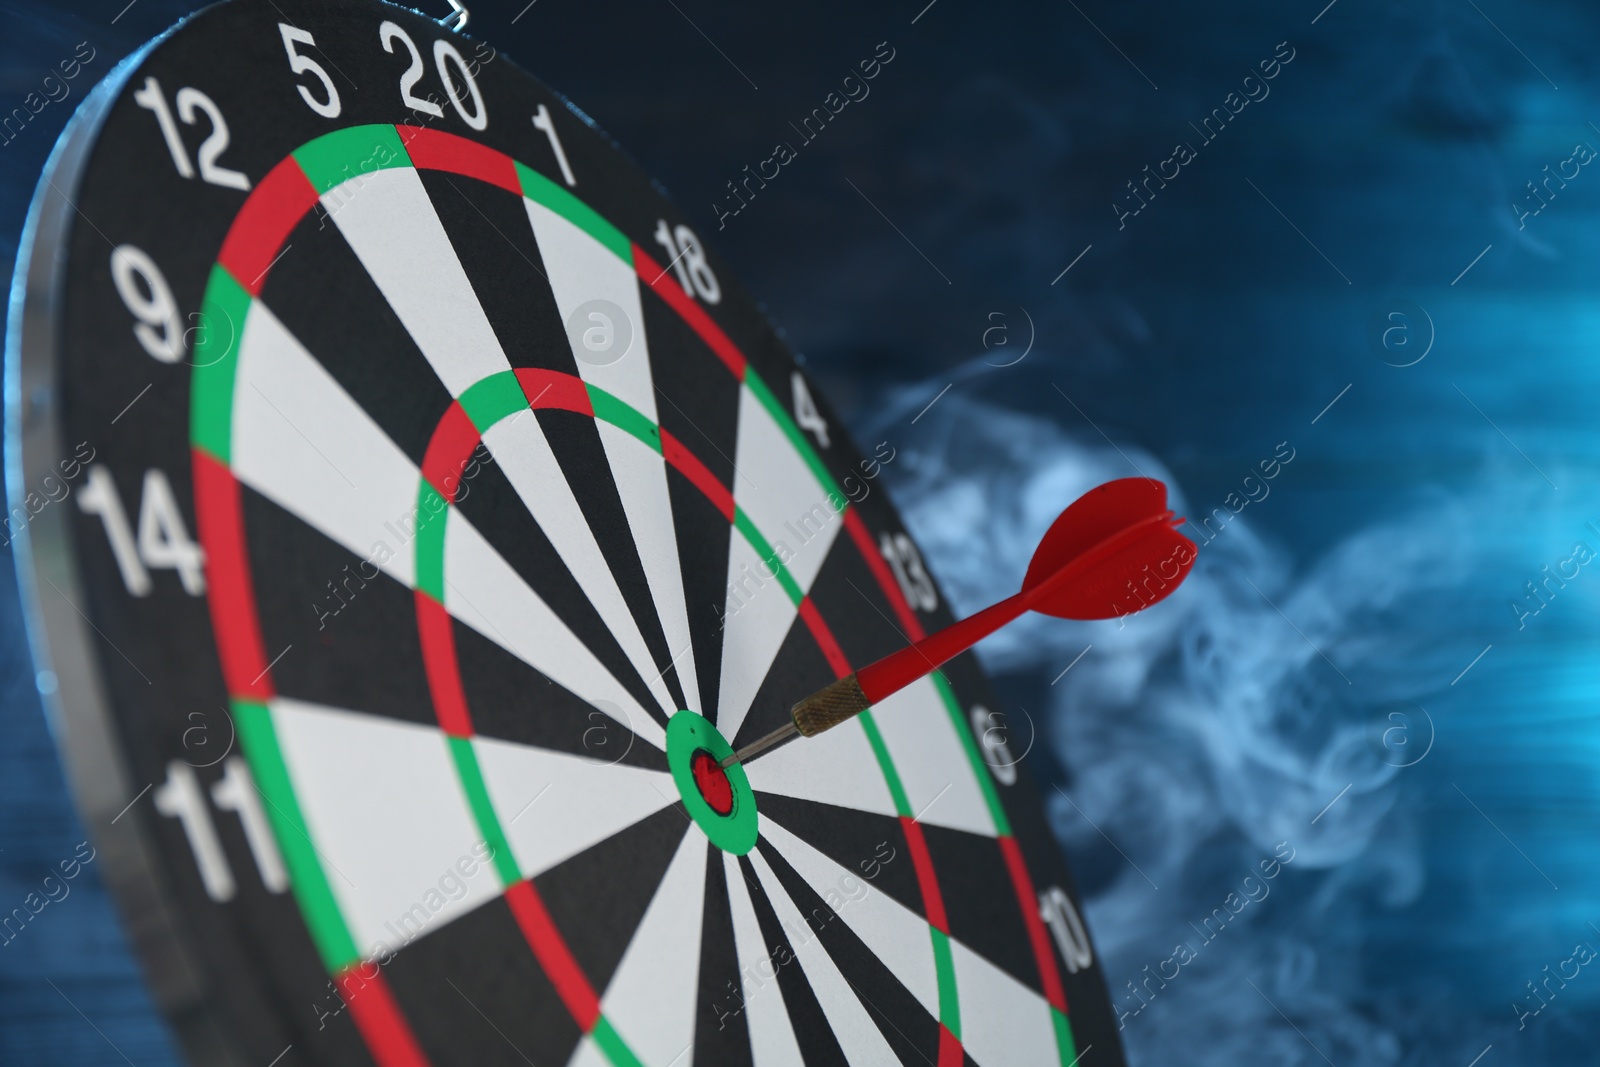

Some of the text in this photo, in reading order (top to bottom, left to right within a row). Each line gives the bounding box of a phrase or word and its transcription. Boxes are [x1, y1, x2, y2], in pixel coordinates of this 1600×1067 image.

[278, 22, 341, 118] 5
[379, 20, 491, 132] 20
[134, 77, 251, 190] 12
[532, 103, 577, 187] 1
[110, 243, 184, 364] 9
[653, 217, 723, 305] 18
[789, 370, 832, 450] 4
[78, 465, 207, 597] 14
[879, 531, 938, 613] 13
[971, 704, 1017, 787] 6
[154, 757, 291, 904] 11
[1038, 885, 1093, 973] 10
